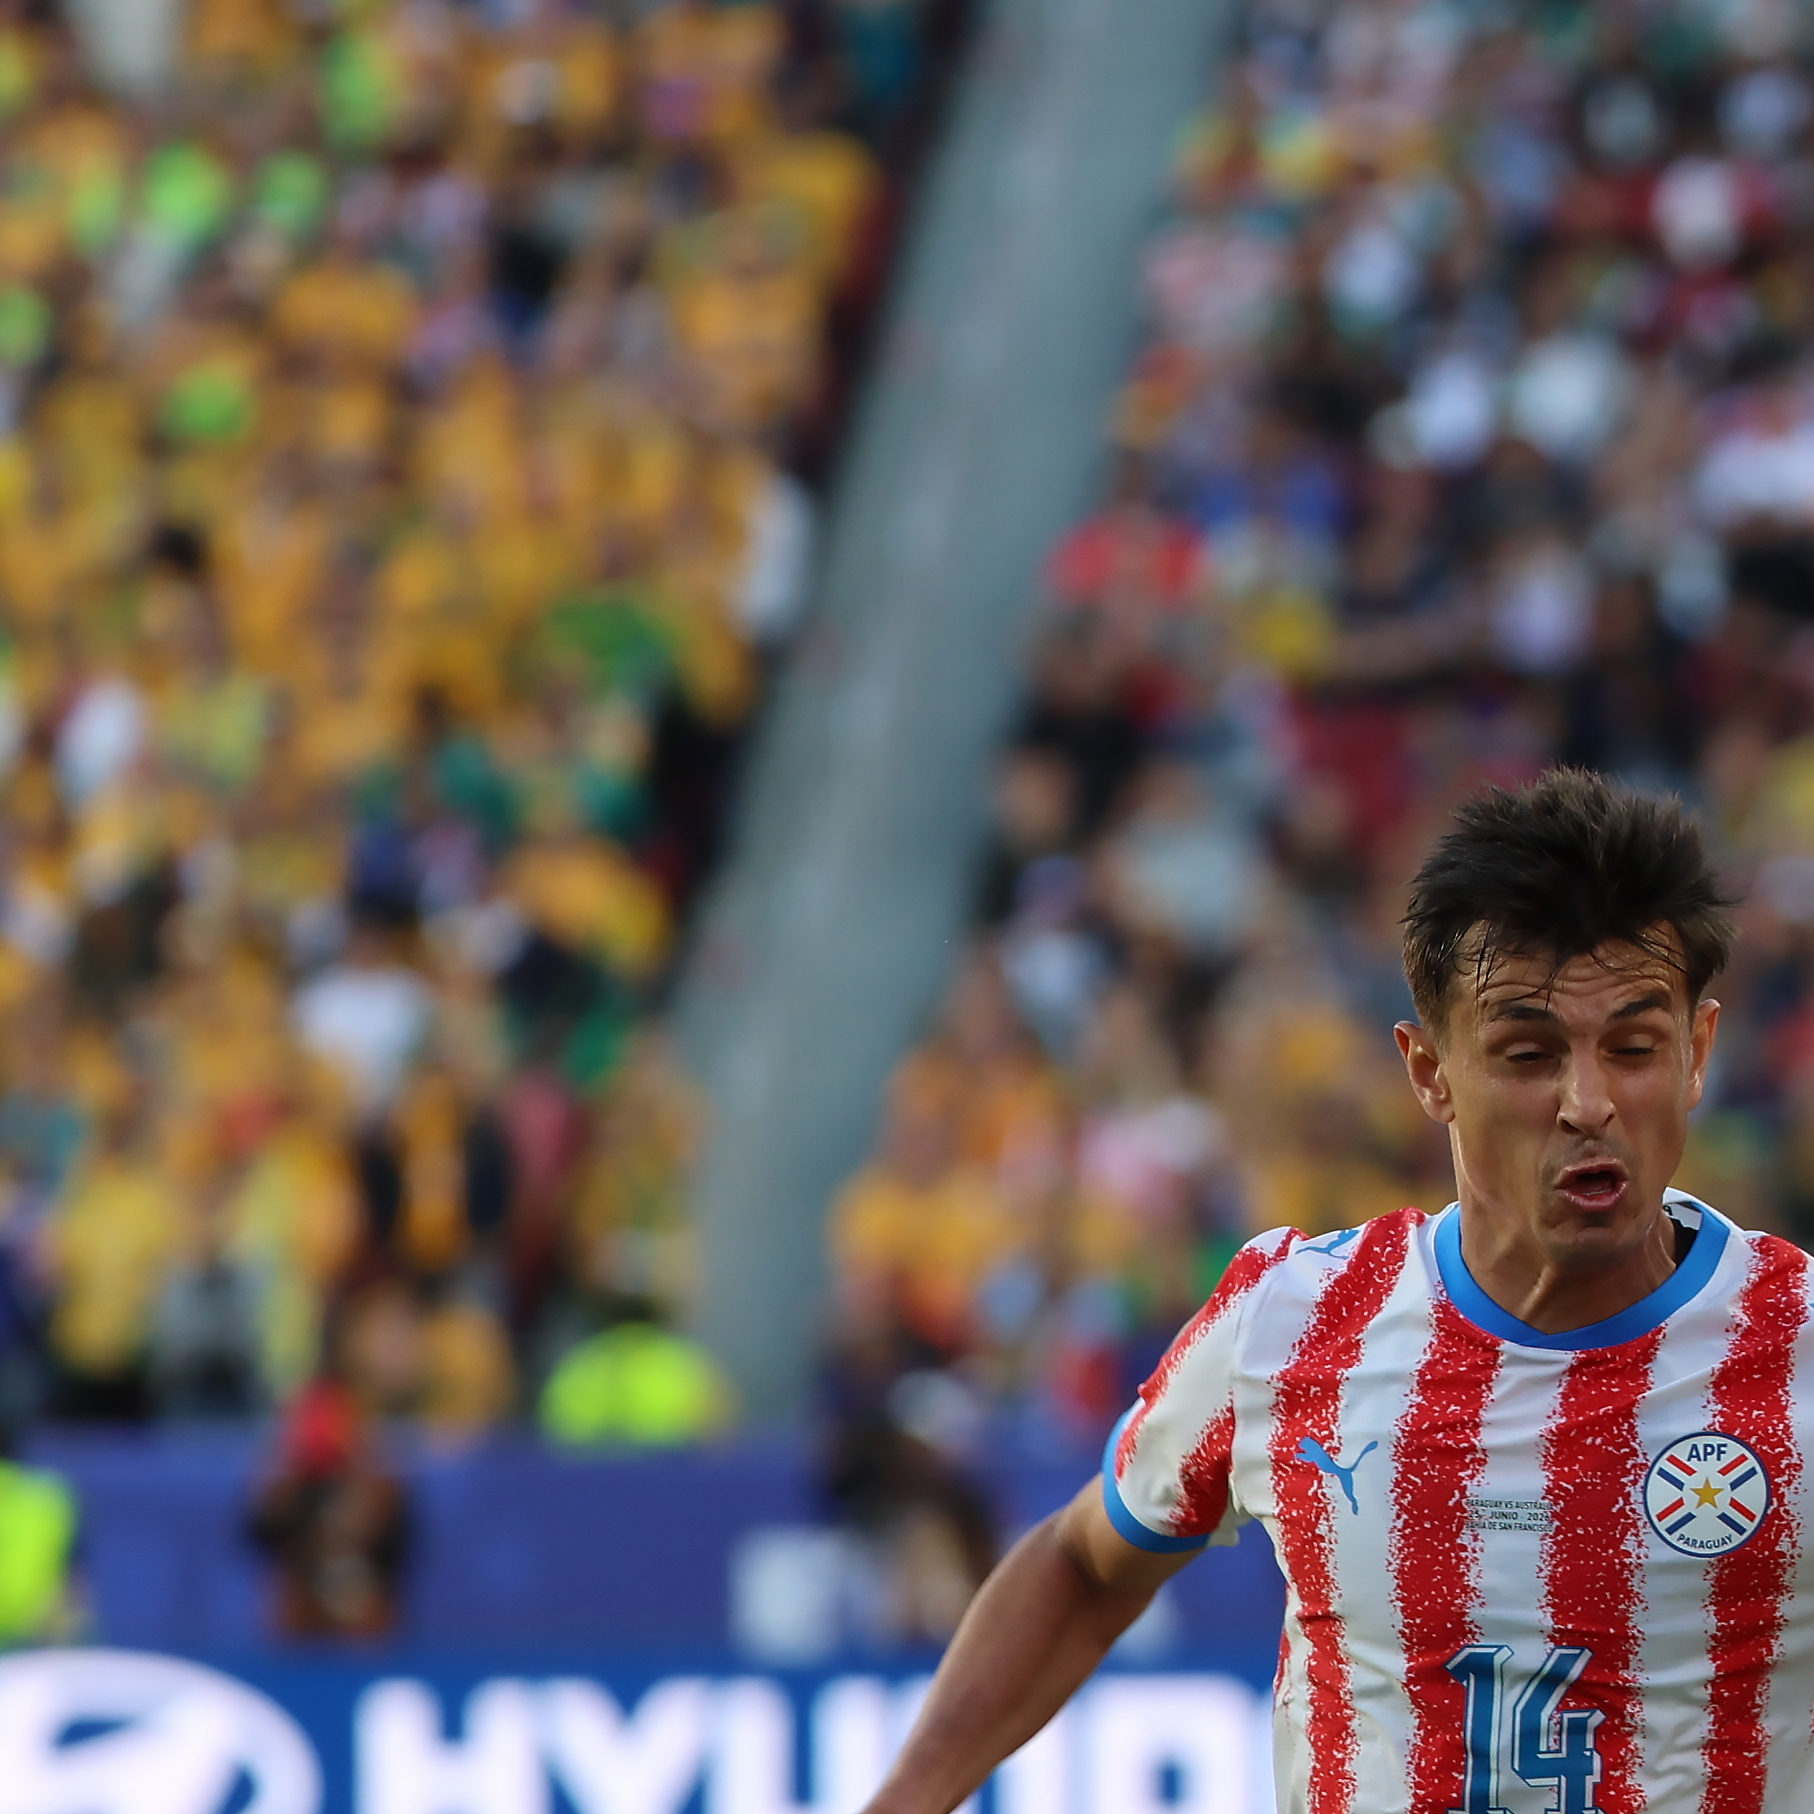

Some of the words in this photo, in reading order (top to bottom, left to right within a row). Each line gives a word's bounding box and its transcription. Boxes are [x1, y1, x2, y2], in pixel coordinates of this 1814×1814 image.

[1686, 1443, 1728, 1462] APF
[1504, 1500, 1513, 1508] VS
[1489, 1511, 1518, 1520] JUNIO
[1499, 1522, 1512, 1531] SAN
[1676, 1533, 1734, 1550] PARAGUAY
